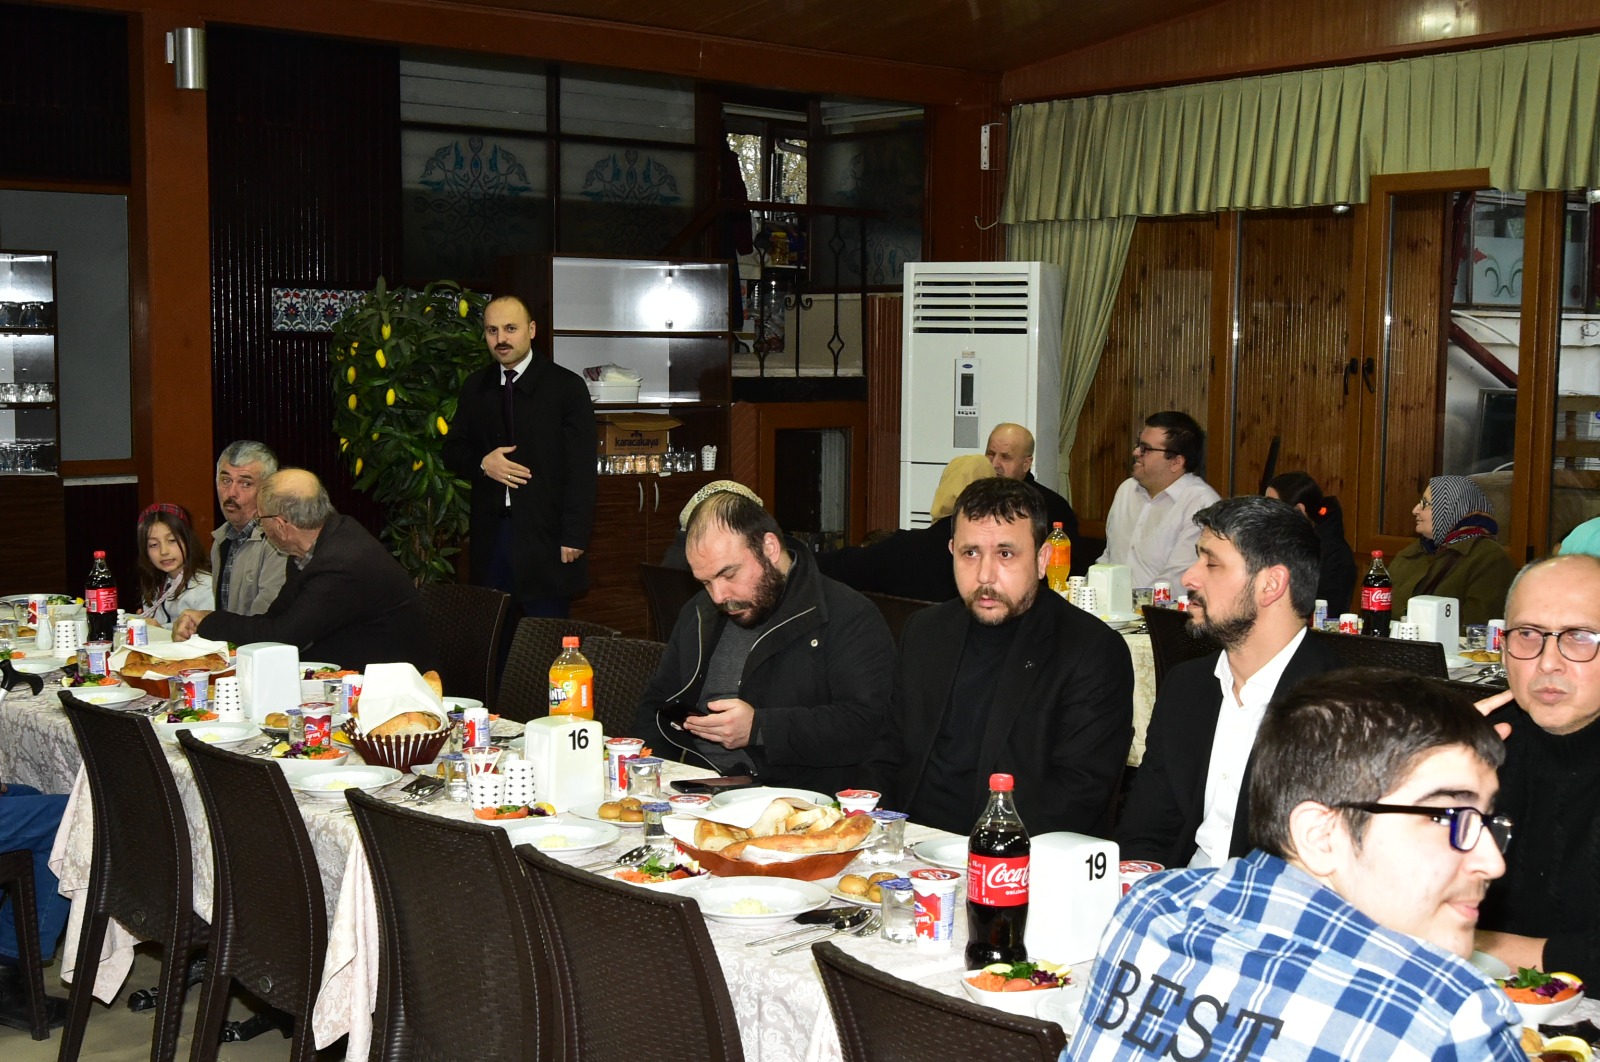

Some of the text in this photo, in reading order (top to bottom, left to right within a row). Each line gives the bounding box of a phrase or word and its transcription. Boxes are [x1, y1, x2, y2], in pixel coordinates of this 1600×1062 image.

[1445, 603, 1452, 618] 8
[568, 728, 590, 751] 16
[1085, 851, 1107, 881] 19
[1094, 959, 1284, 1062] BEST
